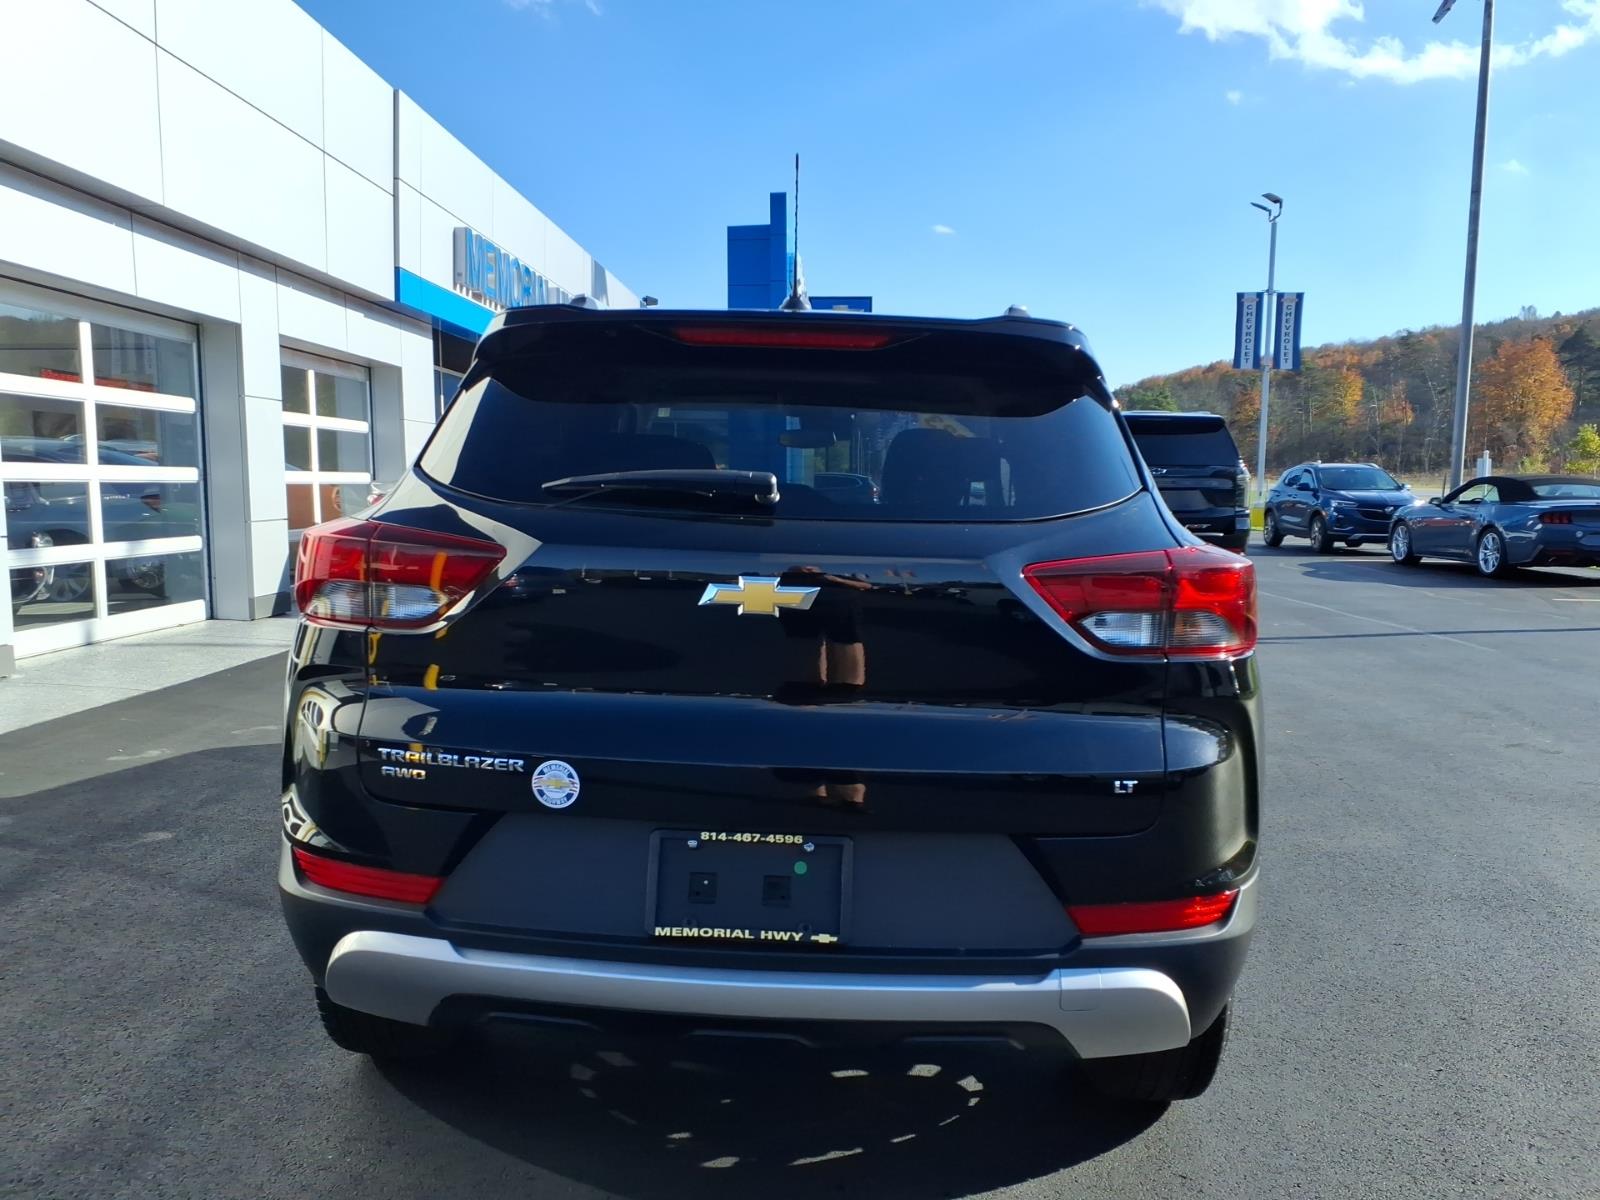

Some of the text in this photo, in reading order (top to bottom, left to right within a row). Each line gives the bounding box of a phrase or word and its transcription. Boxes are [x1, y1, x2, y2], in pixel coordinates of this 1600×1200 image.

[1244, 304, 1253, 364] CHEVROLET
[1283, 304, 1292, 364] CHEVROLET
[377, 747, 525, 773] TRAILBLAZER
[381, 765, 427, 780] AWD
[1114, 780, 1139, 794] LT
[700, 831, 803, 844] 814-467-4596
[655, 926, 804, 942] MEMORIAL HWY
